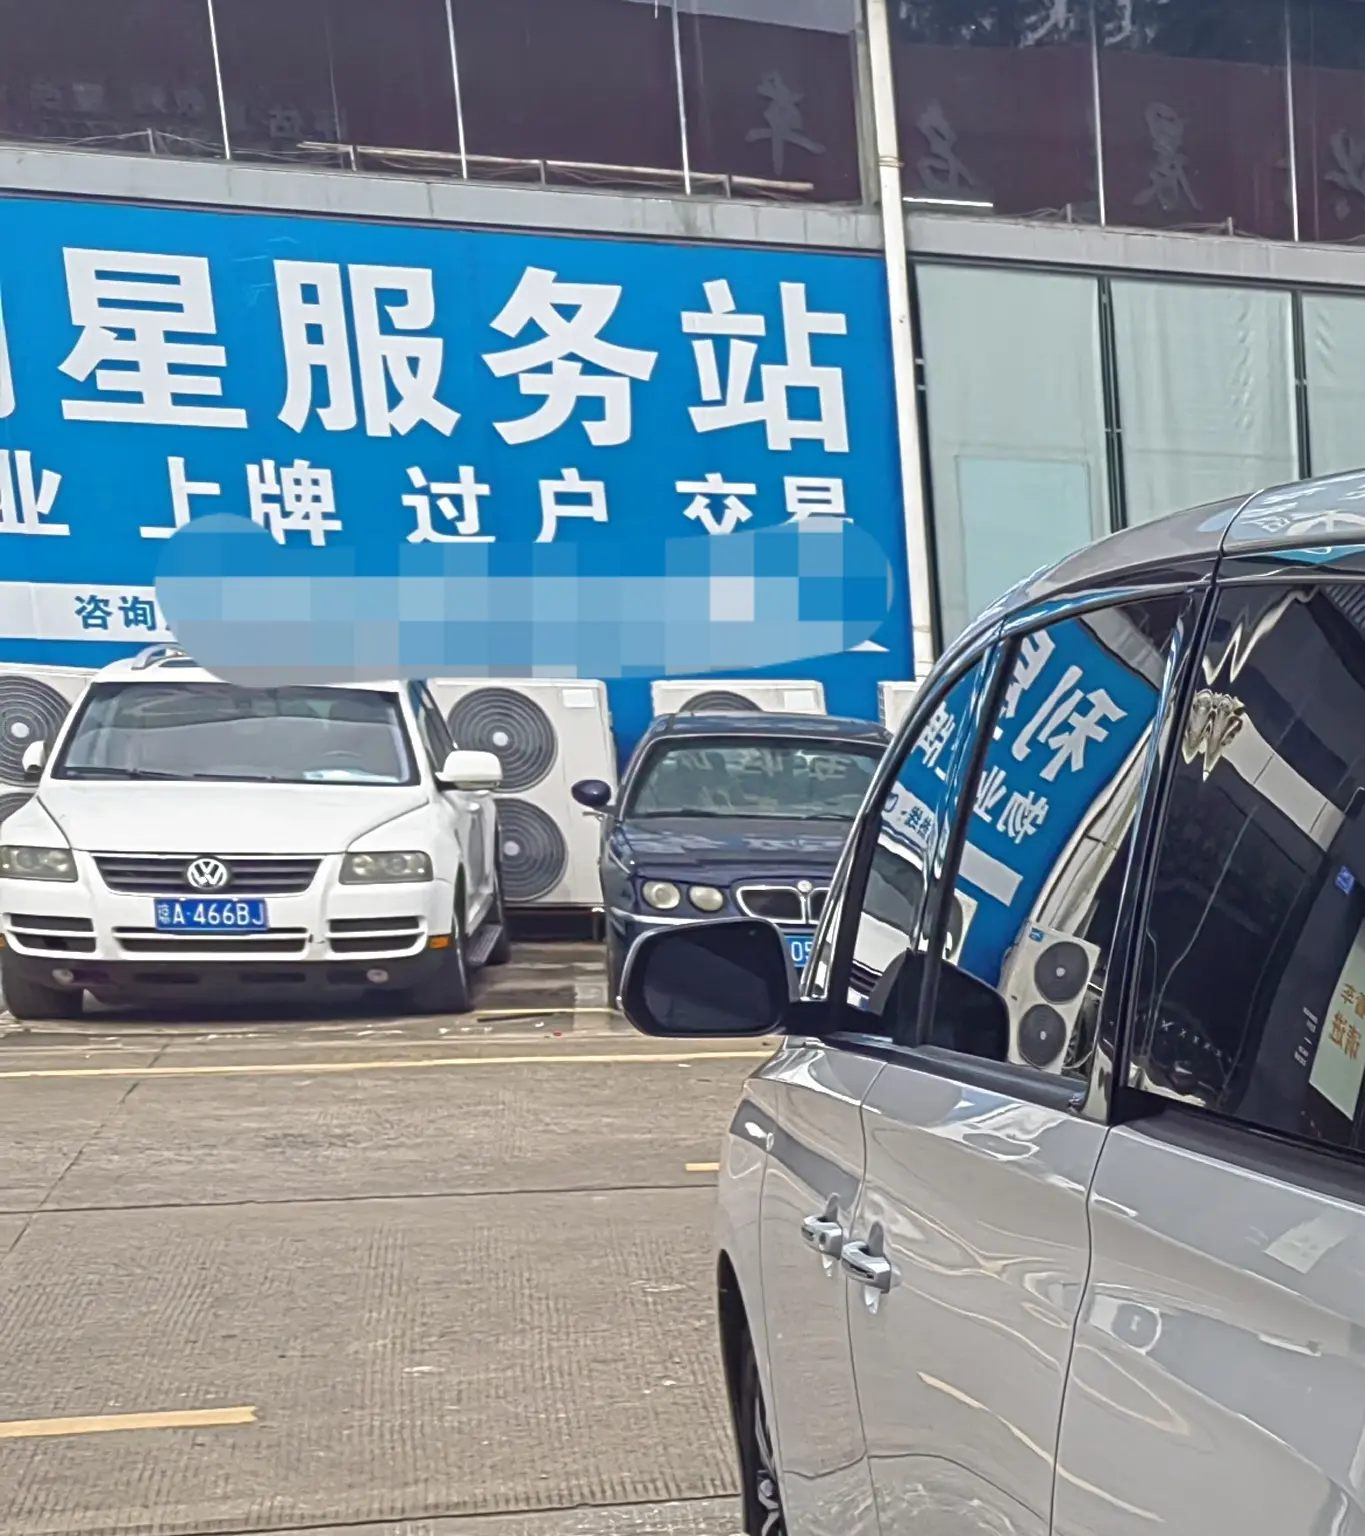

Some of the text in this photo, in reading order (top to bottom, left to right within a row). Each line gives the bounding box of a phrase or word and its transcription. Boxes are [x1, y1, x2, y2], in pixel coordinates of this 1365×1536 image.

[0, 246, 851, 453] 星服务站
[401, 465, 609, 543] 过户
[75, 594, 171, 631] 咨询
